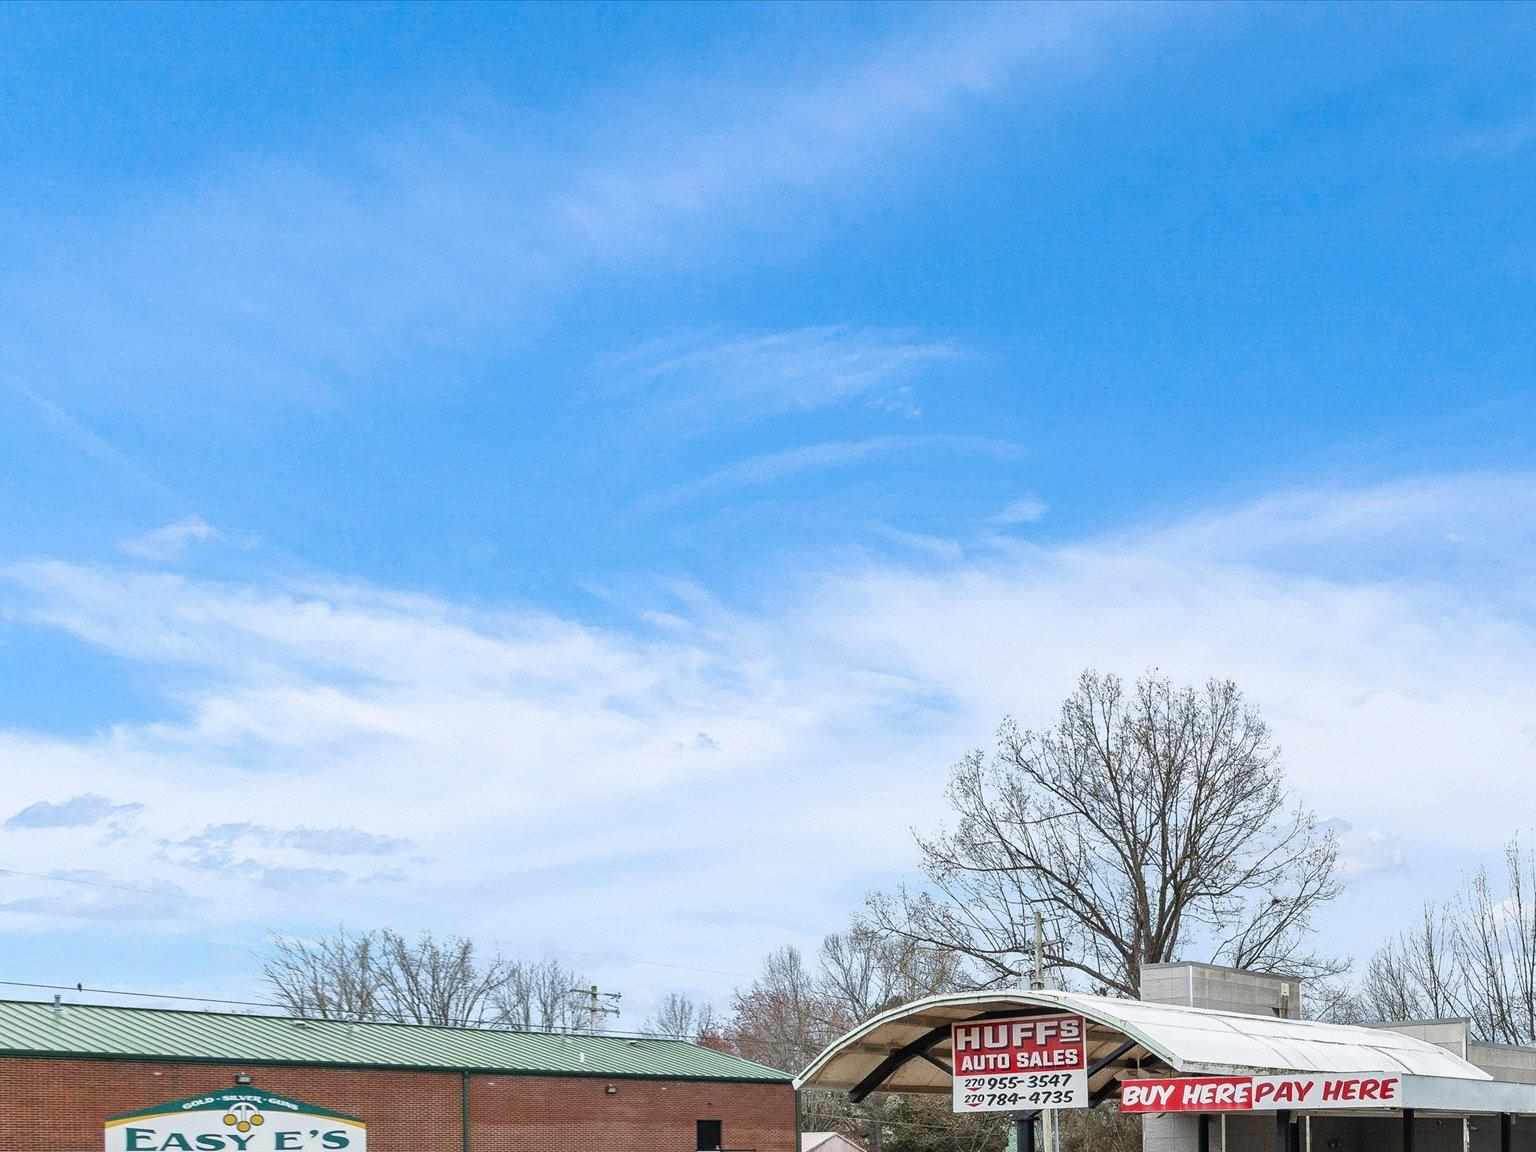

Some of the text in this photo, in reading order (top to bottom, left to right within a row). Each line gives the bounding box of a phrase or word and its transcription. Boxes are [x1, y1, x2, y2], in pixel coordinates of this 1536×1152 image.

[957, 1019, 1080, 1050] HUFFS
[961, 1049, 1078, 1071] AUTO SALES
[964, 1073, 1072, 1090] 270 955-3547
[1121, 1078, 1399, 1106] BUY HERE PAY HERE
[182, 1095, 299, 1110] GOLD SILVER GUNS
[964, 1090, 1074, 1106] 270 784-4735
[126, 1127, 350, 1152] EASY E'S
